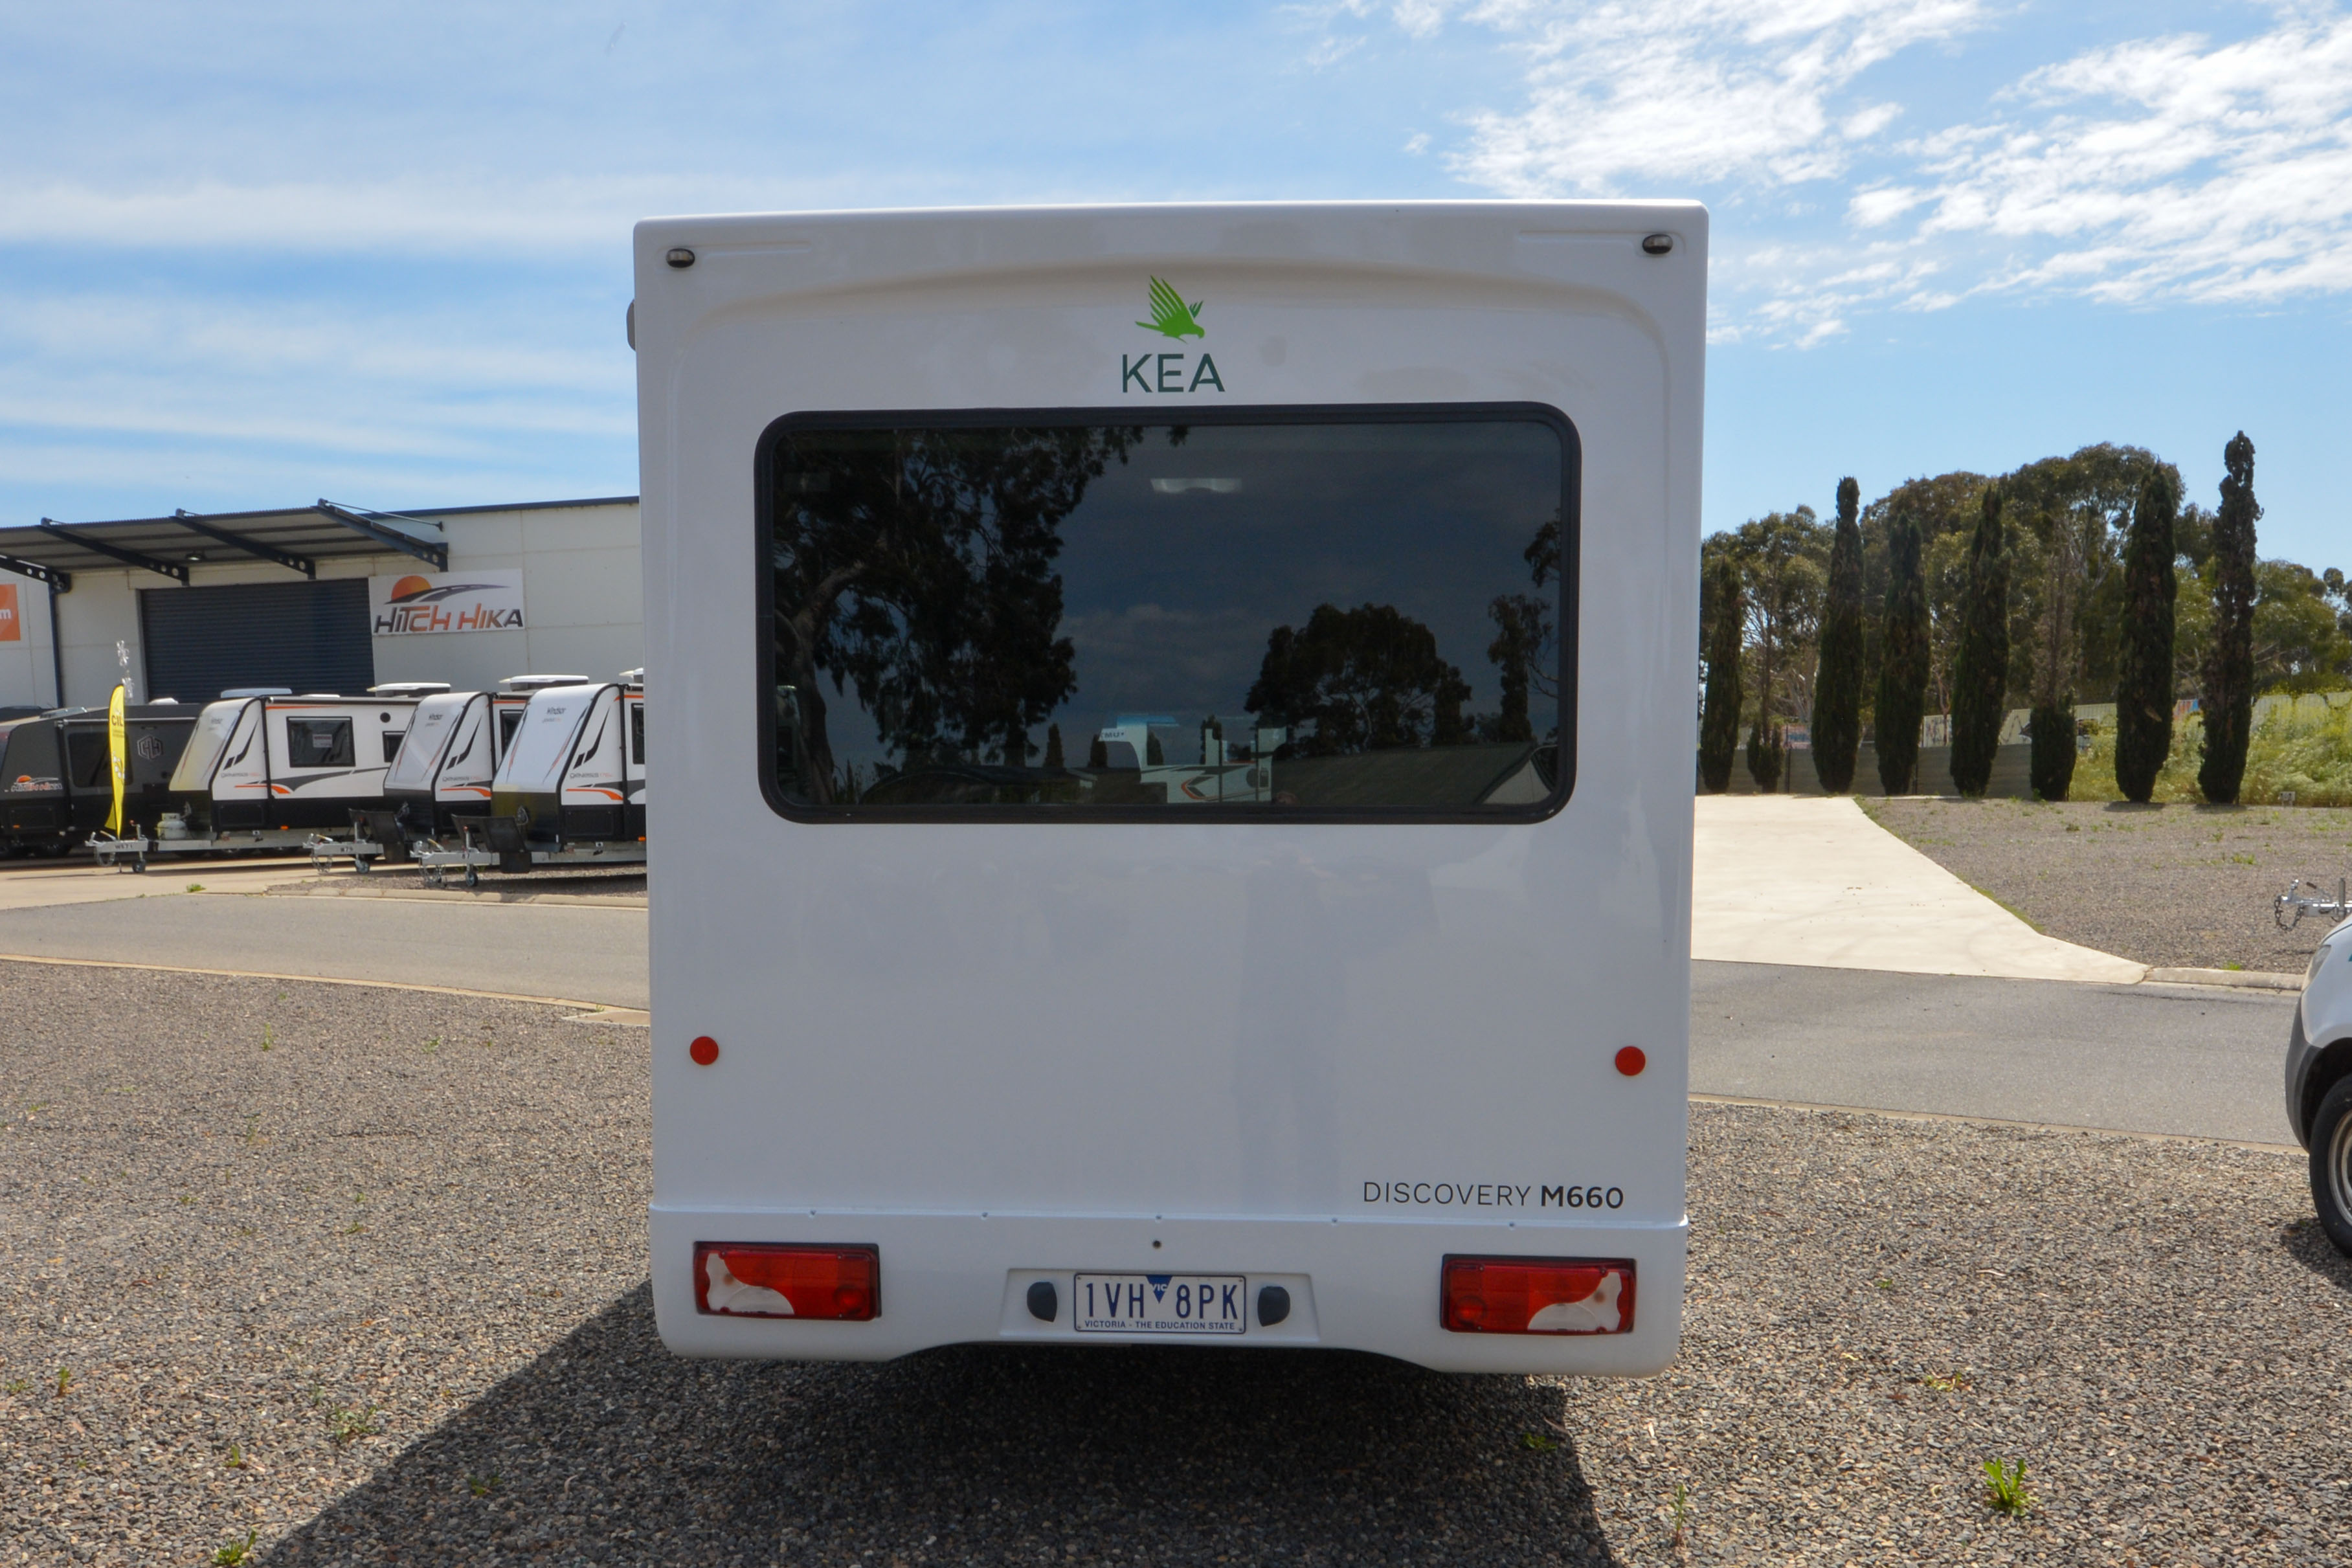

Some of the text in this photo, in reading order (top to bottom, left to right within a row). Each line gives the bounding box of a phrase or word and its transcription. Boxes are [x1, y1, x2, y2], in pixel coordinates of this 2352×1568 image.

[1122, 353, 1225, 393] KEA
[374, 603, 523, 633] HITCH HIKA
[1363, 1182, 1624, 1209] DISCOVERY M660
[1086, 1283, 1238, 1319] 1VH 8PK
